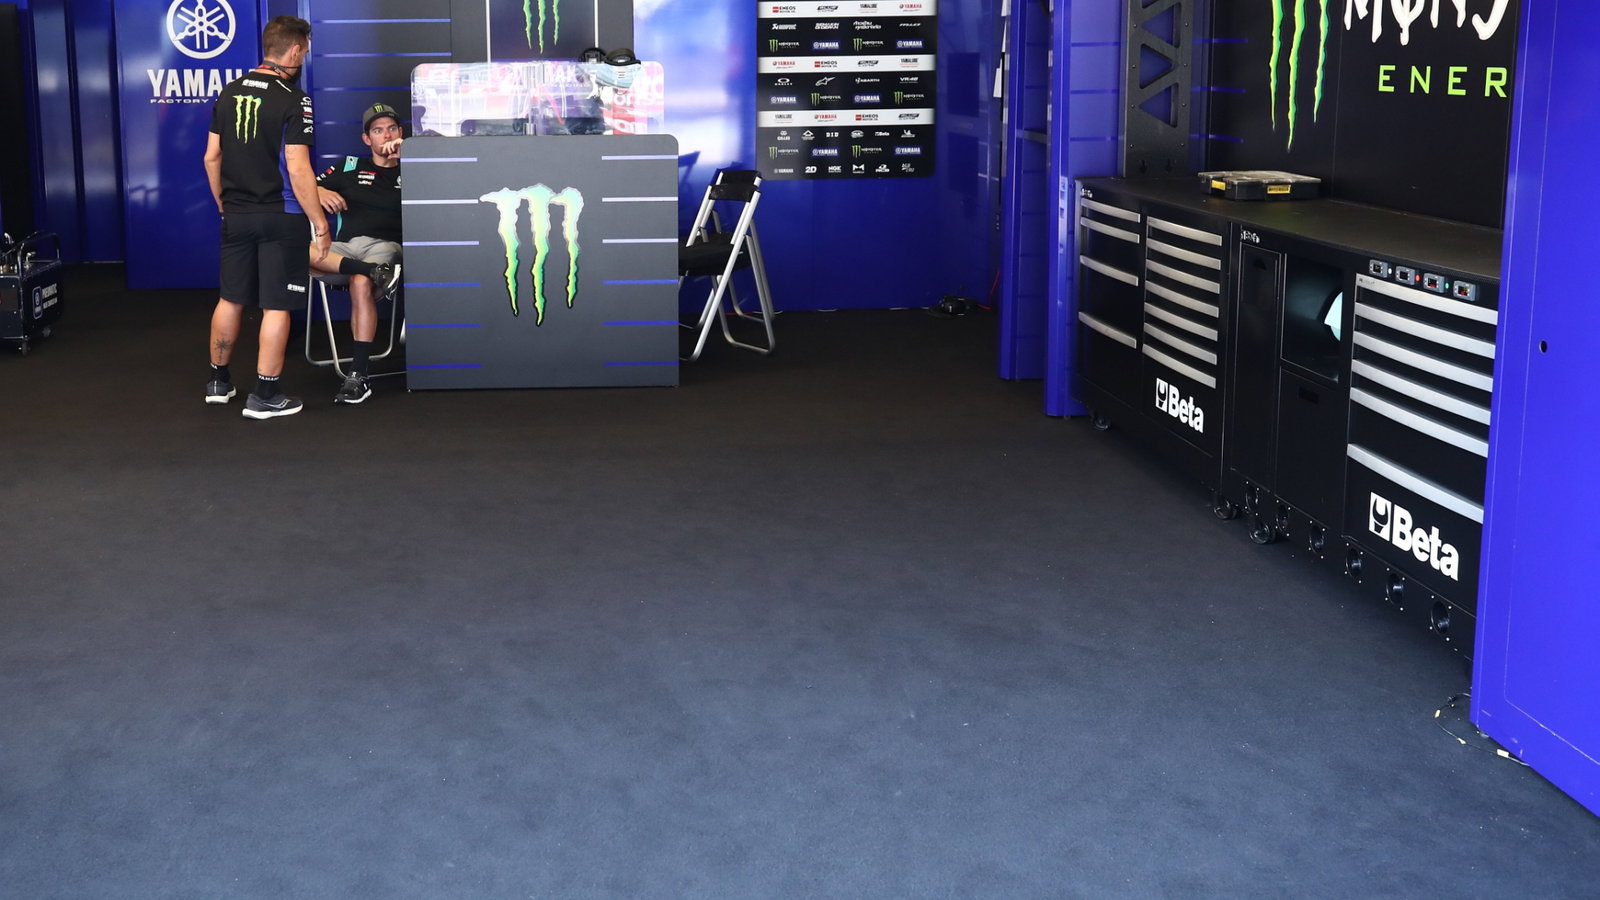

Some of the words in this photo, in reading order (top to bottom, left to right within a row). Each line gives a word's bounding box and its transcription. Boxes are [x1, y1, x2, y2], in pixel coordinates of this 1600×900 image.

[1378, 65, 1508, 97] ENER
[1168, 384, 1204, 433] Beta
[1392, 504, 1459, 581] Beta
